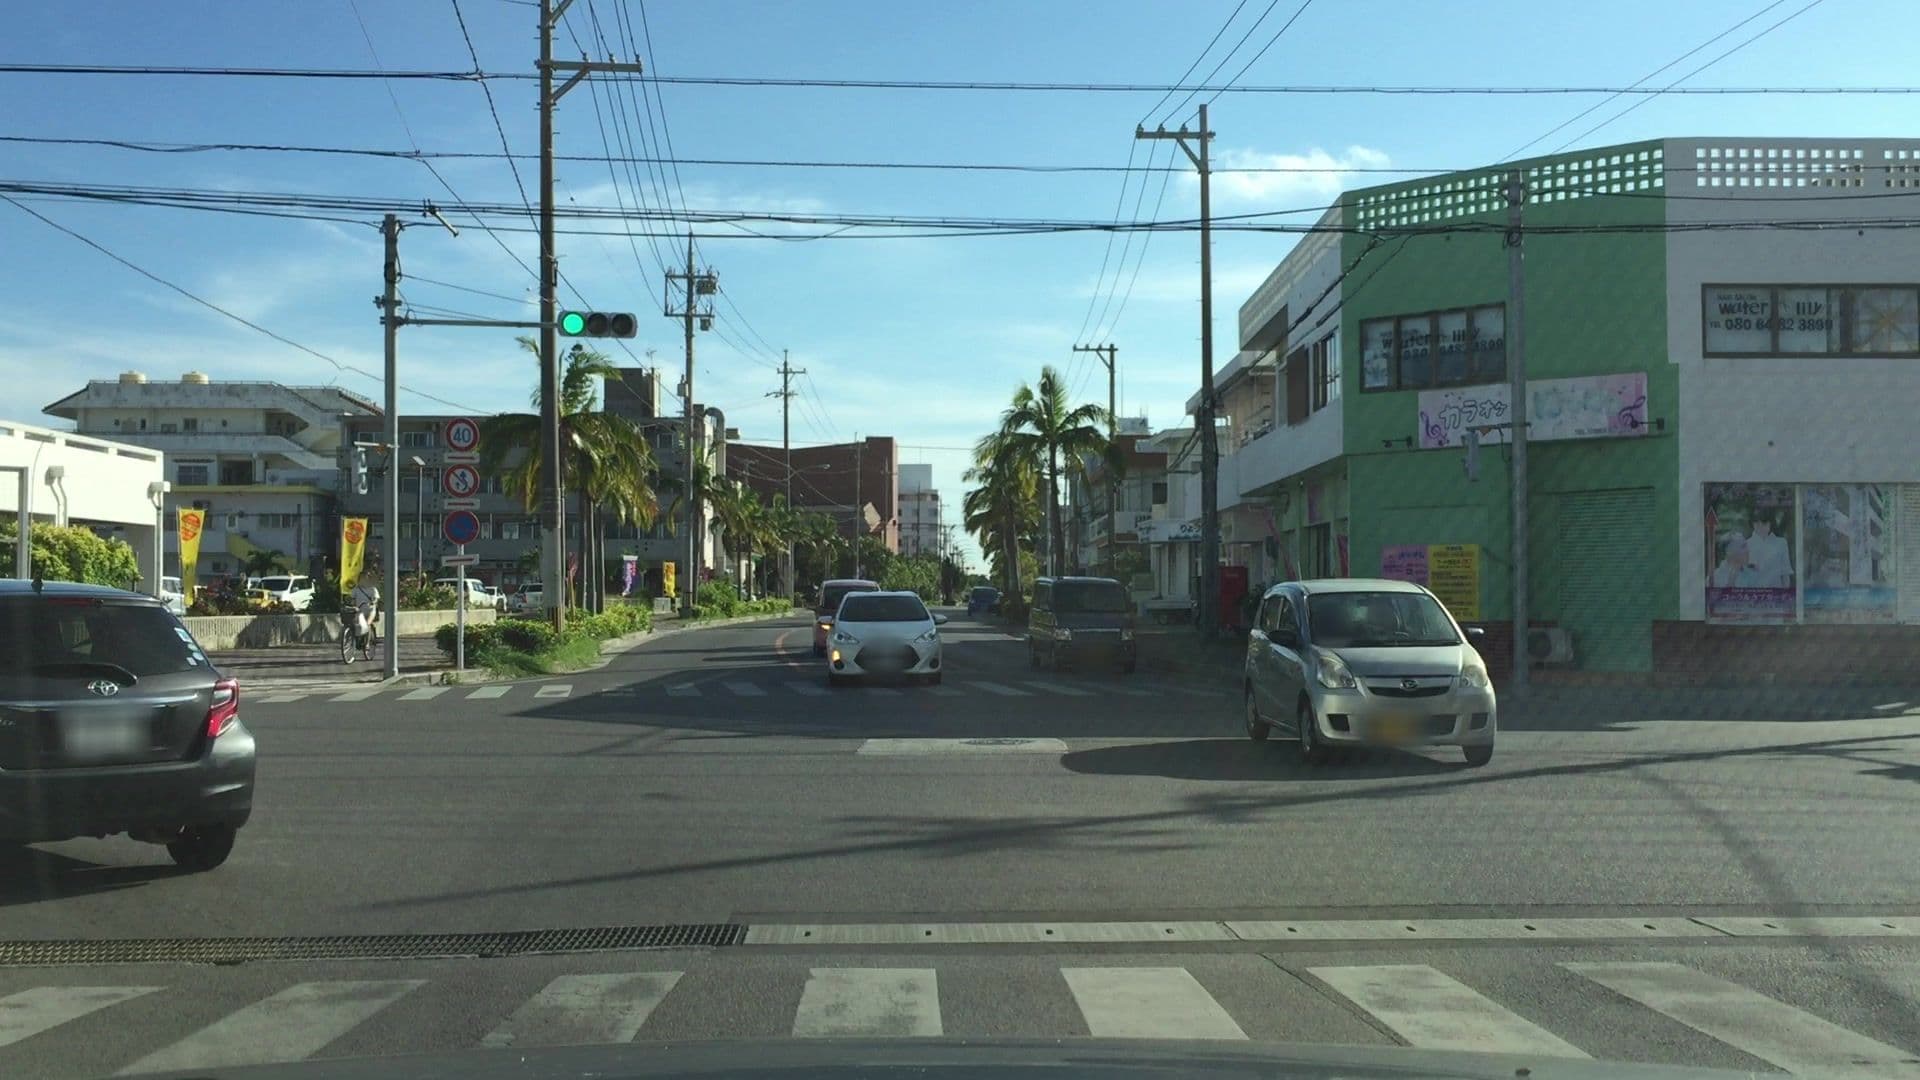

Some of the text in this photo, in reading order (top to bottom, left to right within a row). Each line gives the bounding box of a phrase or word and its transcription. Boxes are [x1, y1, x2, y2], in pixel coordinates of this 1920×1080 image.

[1719, 301, 1823, 315] water lily
[1725, 318, 1752, 331] 080
[1439, 400, 1508, 430] カラオケ
[453, 428, 471, 443] 40
